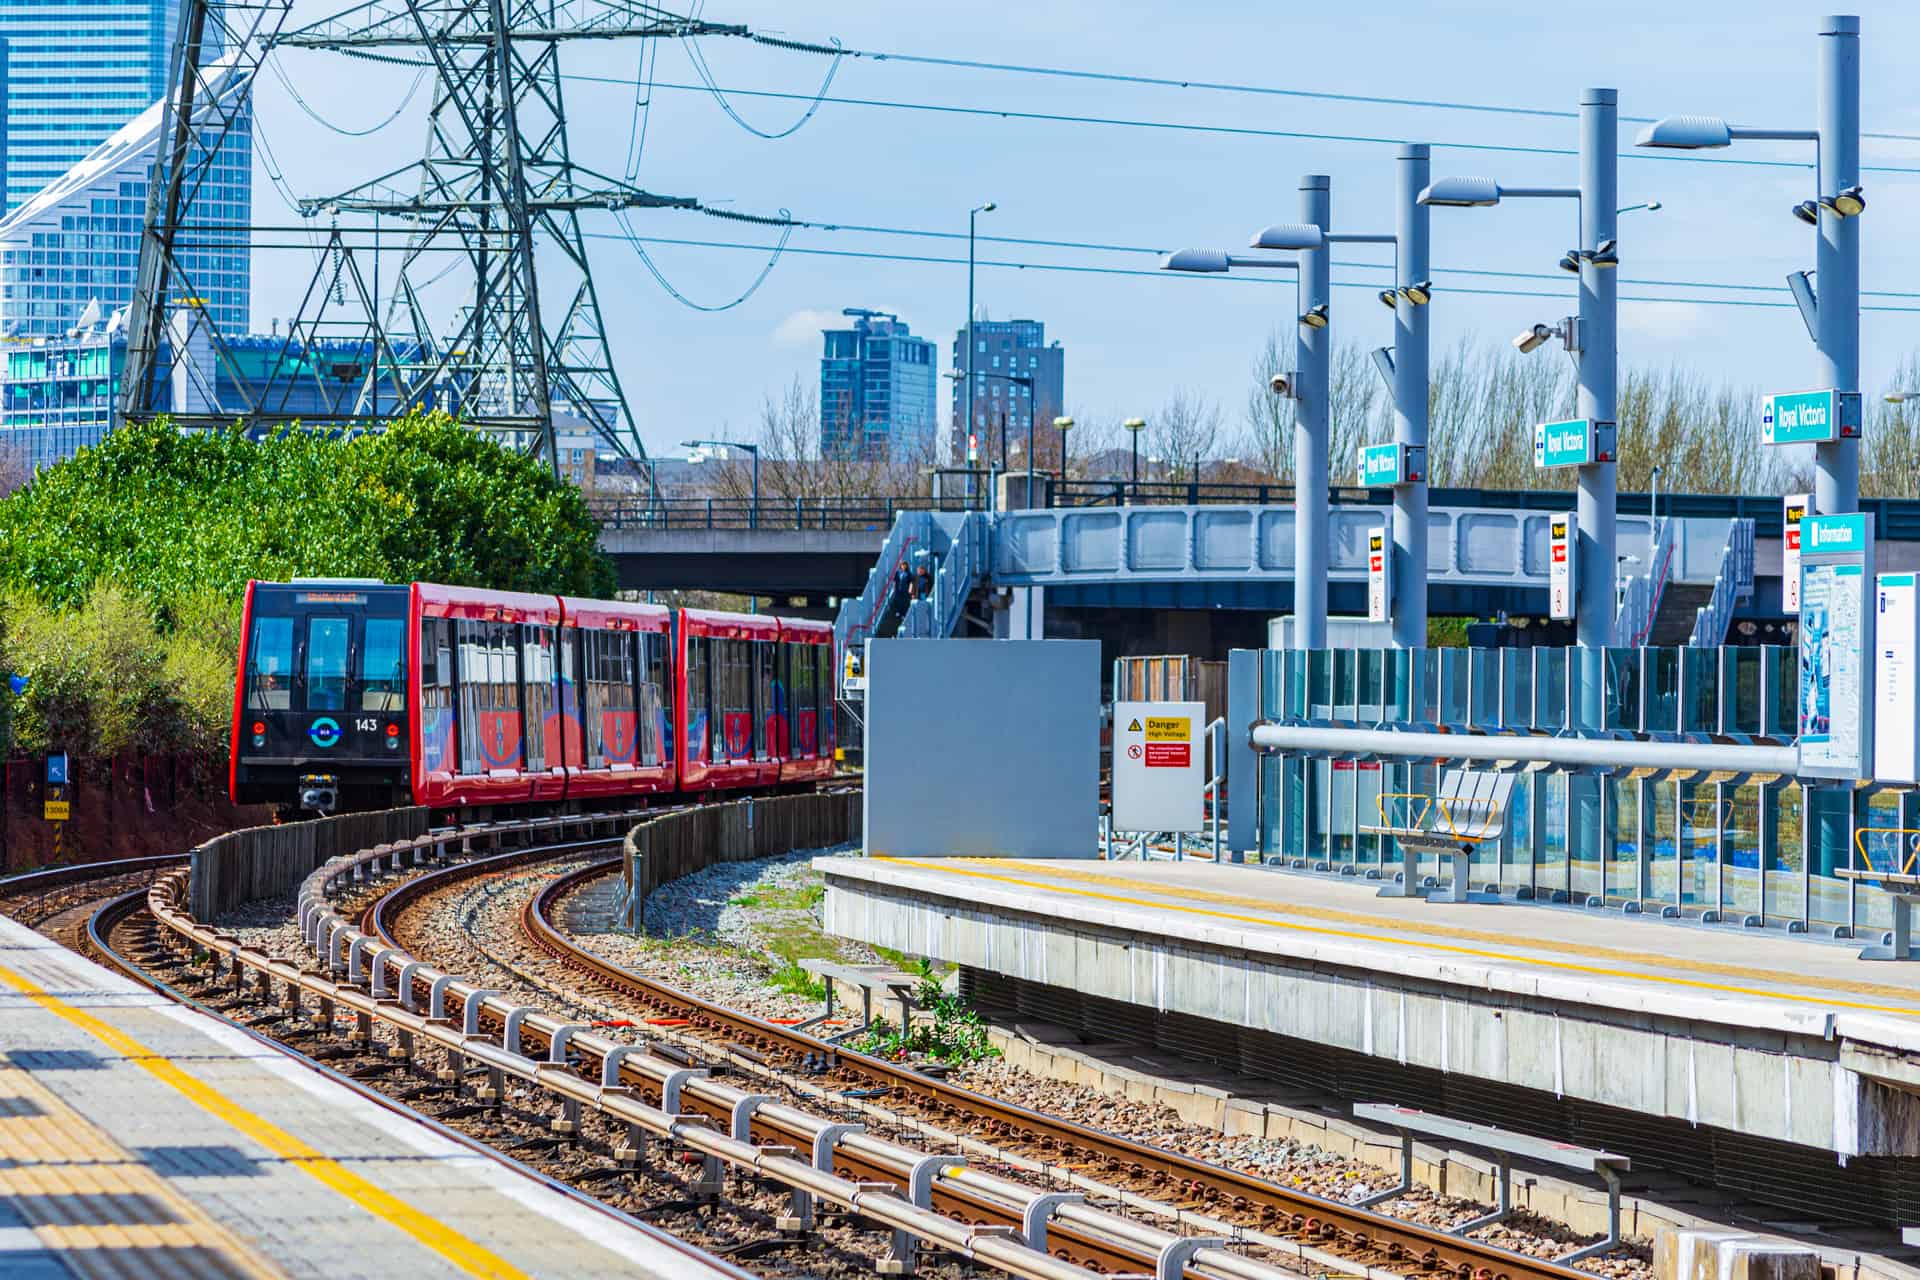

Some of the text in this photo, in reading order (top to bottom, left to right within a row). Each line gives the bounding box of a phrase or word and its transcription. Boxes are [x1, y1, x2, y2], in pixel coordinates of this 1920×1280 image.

[1779, 402, 1826, 433] Royal Victoria
[1819, 521, 1853, 543] Information
[355, 718, 377, 731] 143
[1149, 720, 1179, 729] Danger
